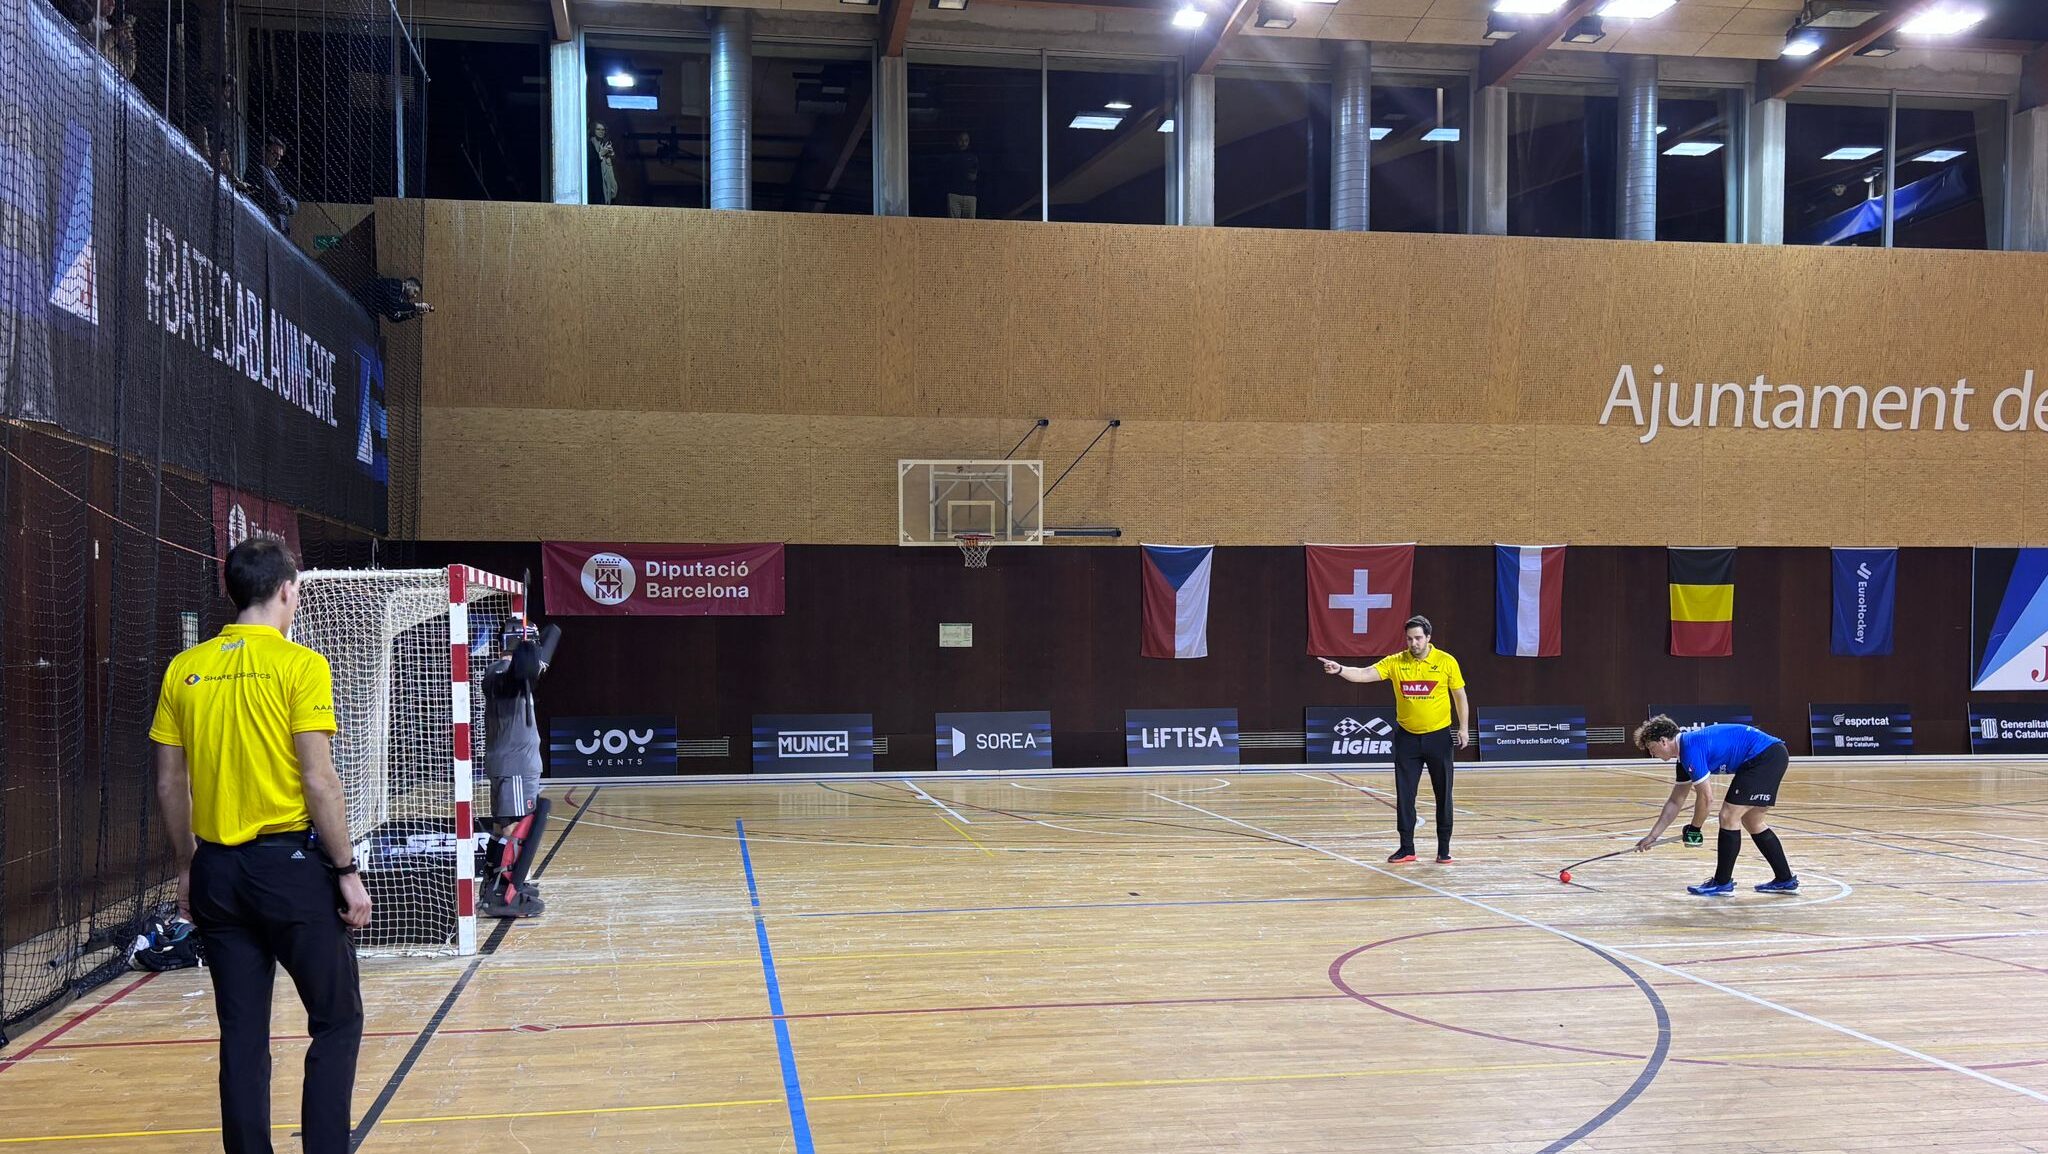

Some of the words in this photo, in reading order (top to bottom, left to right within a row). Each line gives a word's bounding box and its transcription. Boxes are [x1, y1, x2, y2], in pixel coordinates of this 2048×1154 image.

[1599, 364, 1975, 444] Ajuntament
[645, 561, 749, 580] Diputació
[646, 583, 749, 598] Barcelona
[1855, 581, 1867, 644] EuroHockey
[1494, 723, 1571, 731] PORSCHE
[1845, 716, 1889, 727] esportcat
[976, 732, 1037, 750] SOREA
[2001, 730, 2013, 738] de
[778, 736, 847, 752] MUNICH
